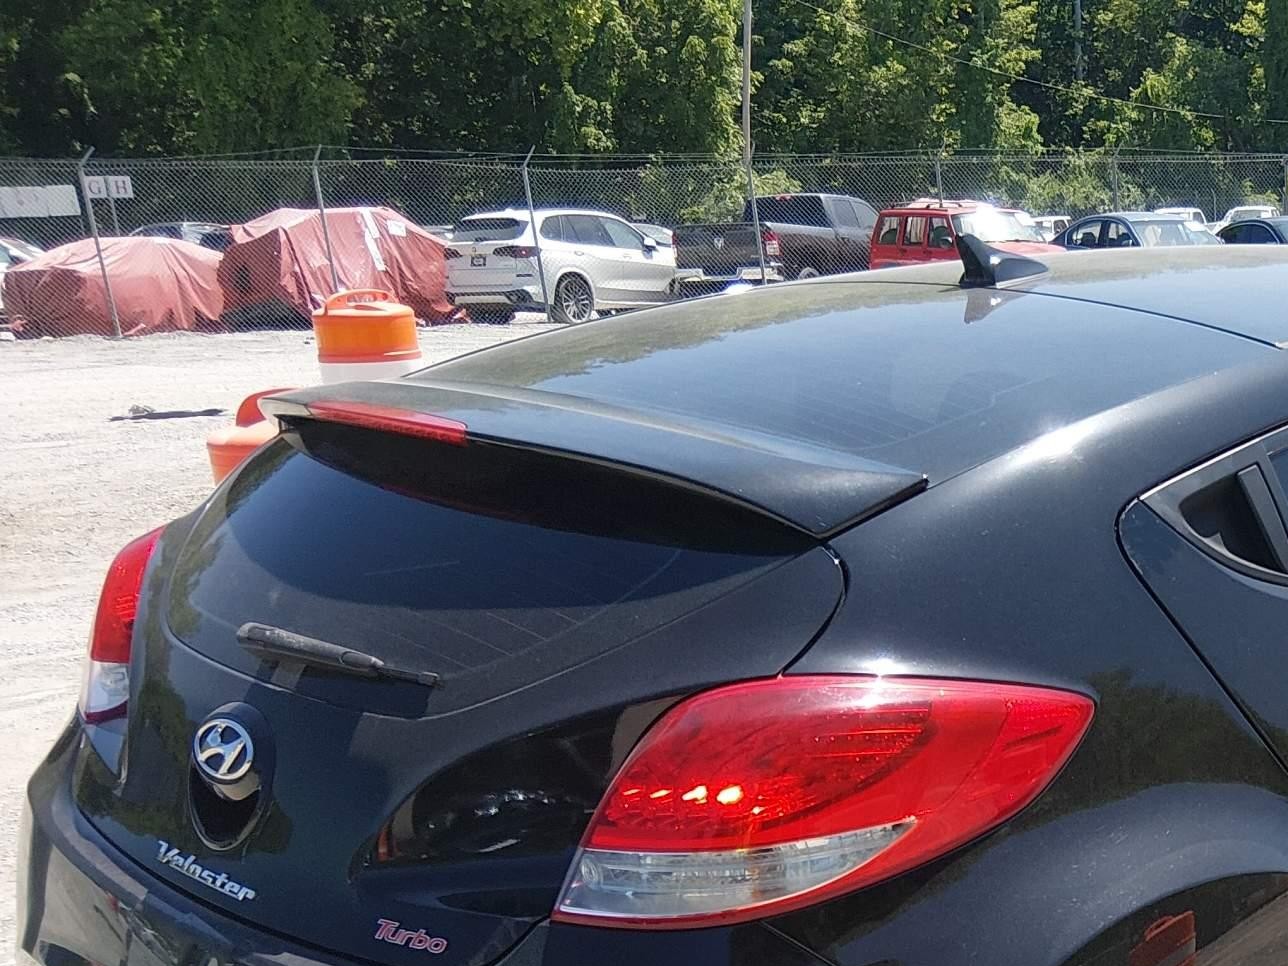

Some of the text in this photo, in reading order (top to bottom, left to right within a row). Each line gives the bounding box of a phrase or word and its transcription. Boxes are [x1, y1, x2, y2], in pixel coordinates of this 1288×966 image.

[88, 180, 101, 194] G
[114, 180, 128, 194] H
[157, 840, 256, 901] Veloster
[374, 918, 448, 954] Turbo
